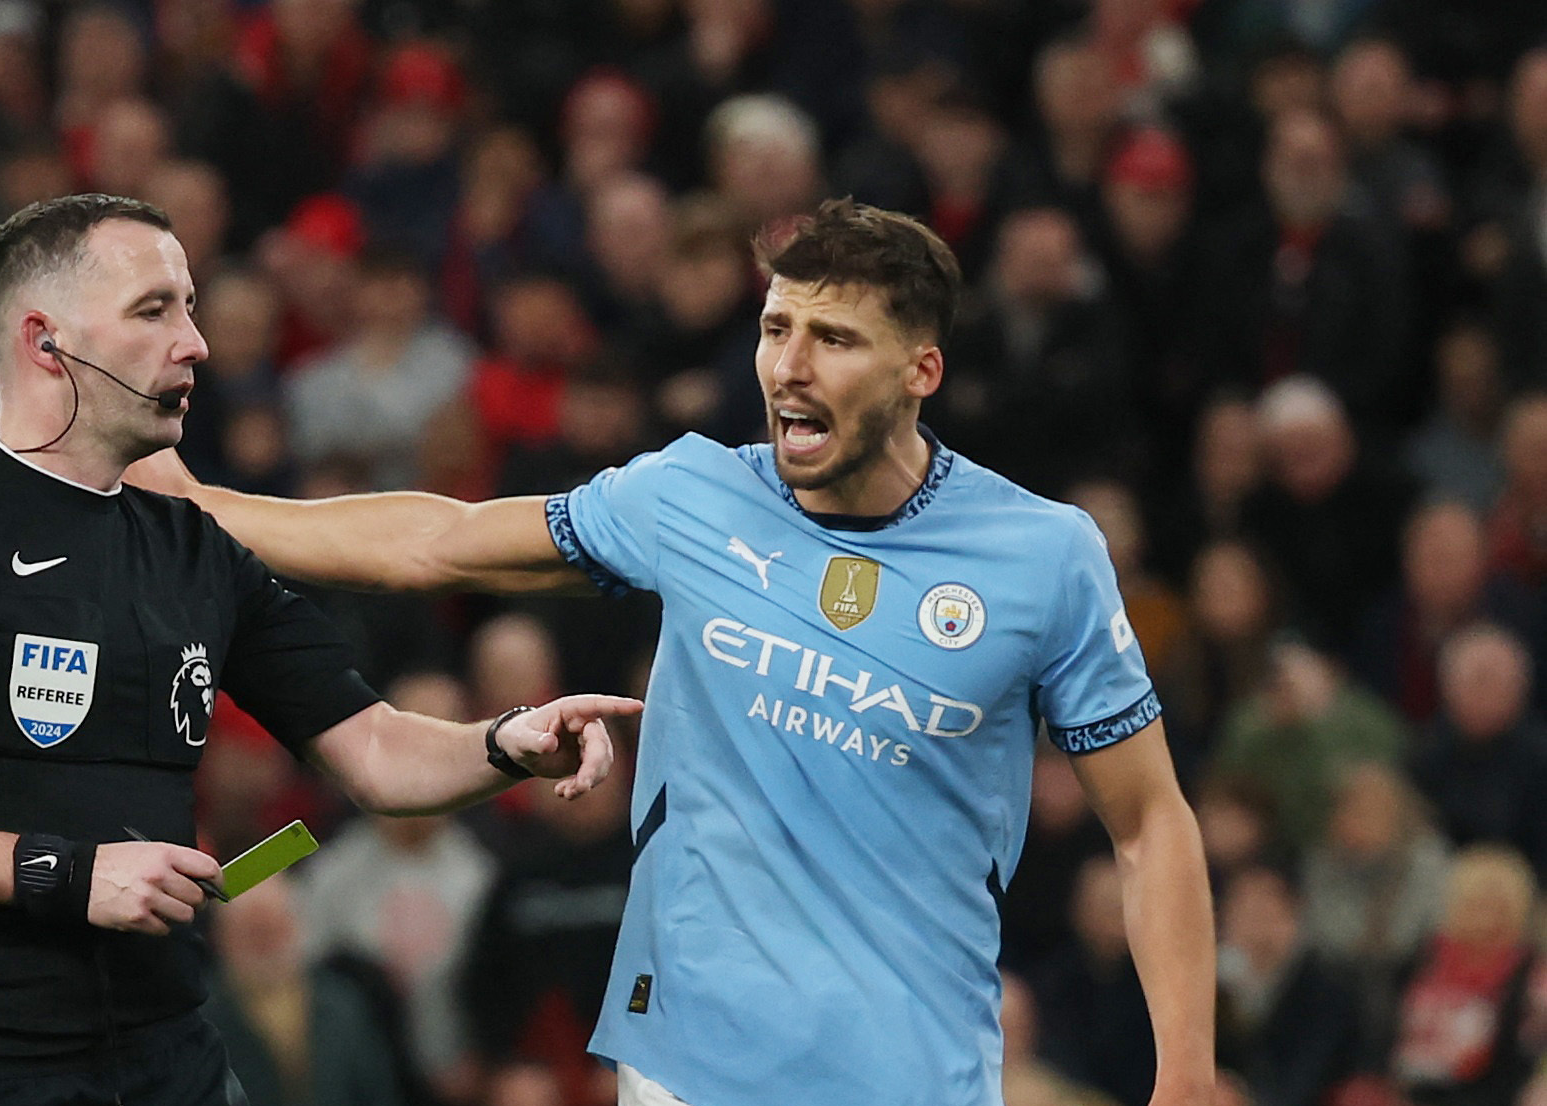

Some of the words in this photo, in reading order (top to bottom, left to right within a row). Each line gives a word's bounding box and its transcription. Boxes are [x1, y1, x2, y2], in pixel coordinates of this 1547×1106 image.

[833, 601, 859, 614] FIFA
[927, 587, 981, 612] MANCHESTER
[938, 637, 960, 647] CITY
[21, 642, 88, 675] FIFA
[702, 617, 983, 738] ETIHAD
[16, 685, 85, 706] REFEREE
[29, 722, 62, 738] 2024
[747, 692, 912, 766] AIRWAYS
